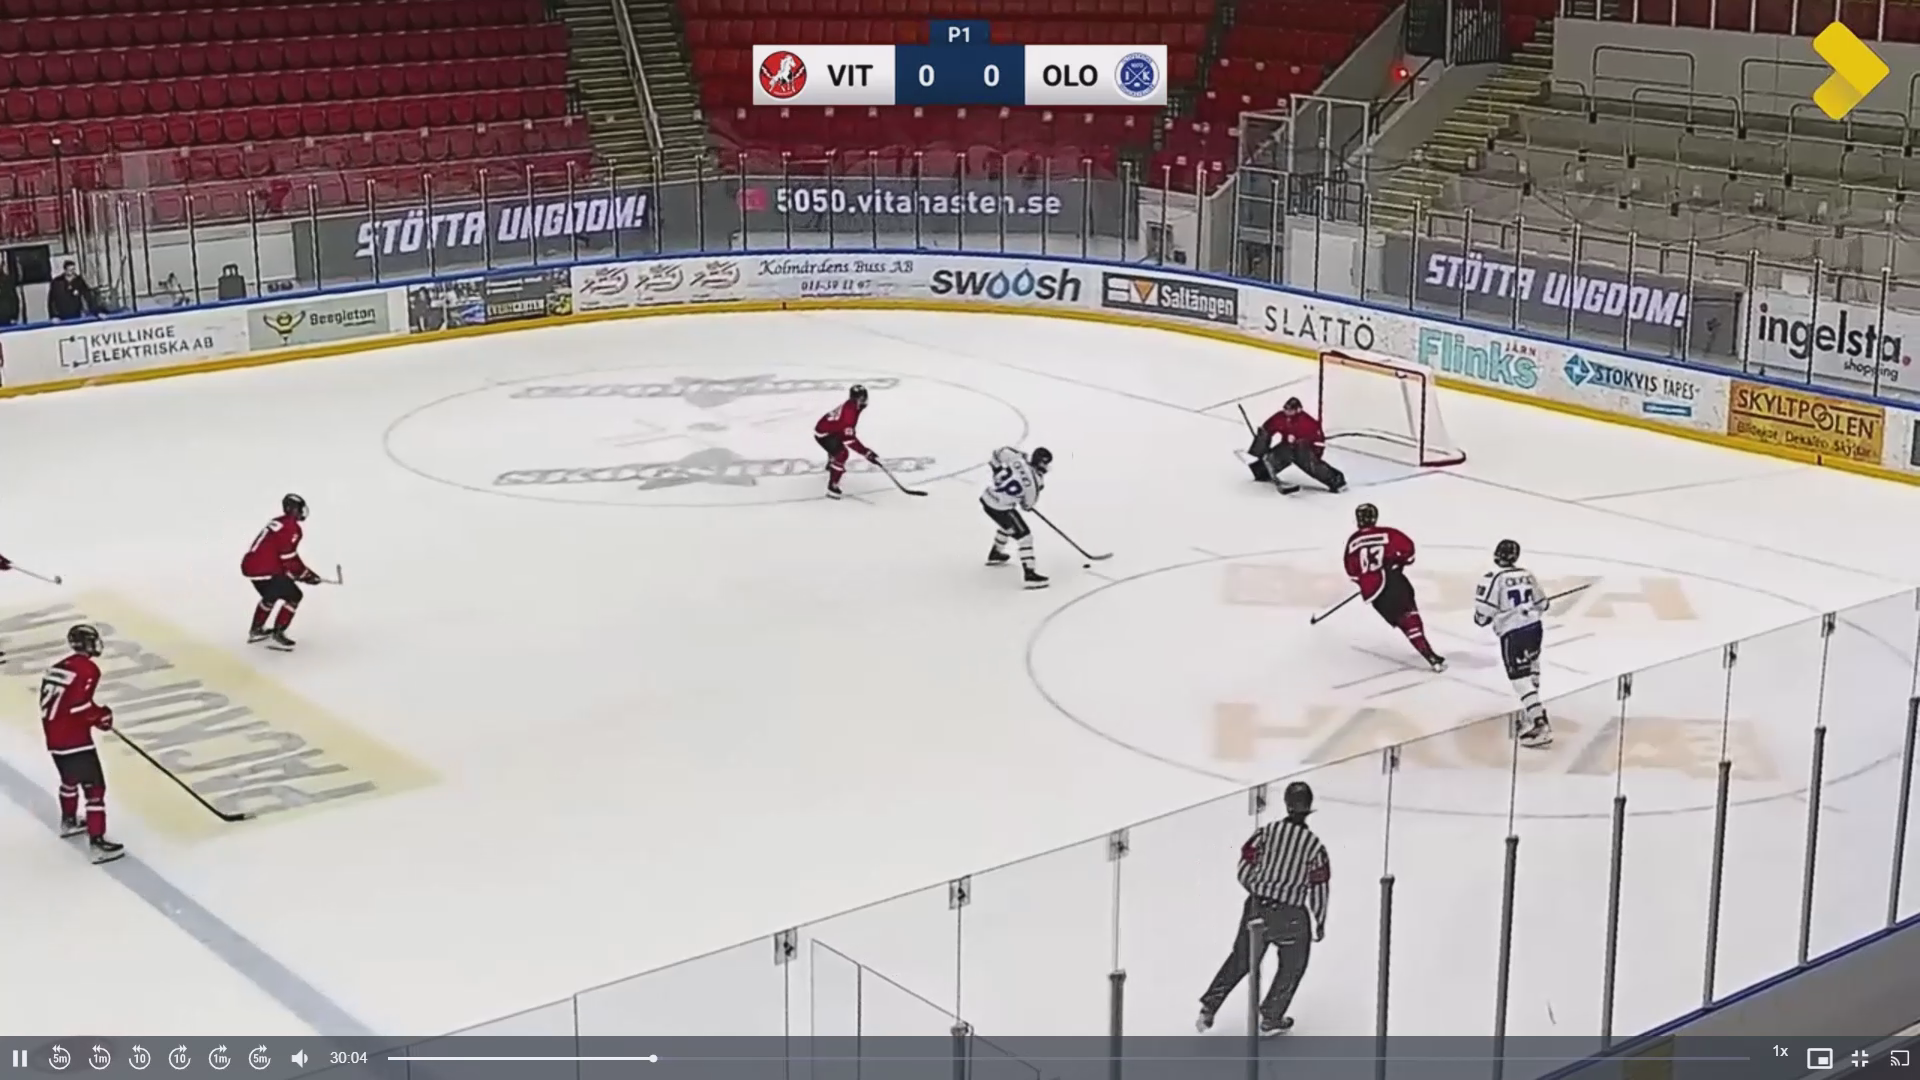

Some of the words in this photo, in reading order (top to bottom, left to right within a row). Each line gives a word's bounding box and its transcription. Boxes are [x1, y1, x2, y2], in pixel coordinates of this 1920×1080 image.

[355, 209, 486, 258] STÖTTA
[498, 195, 647, 242] UNGDOM!
[929, 267, 1082, 302] swoosh
[1160, 284, 1235, 320] Saltängen
[1425, 251, 1537, 301] STÖTTA
[1542, 271, 1688, 328] UNGDOM!
[91, 325, 176, 348] KVILLINGE
[1265, 304, 1375, 351] SLÄTTÖ
[92, 339, 190, 364] ELEKTRISKA
[192, 336, 215, 351] AB
[1418, 326, 1539, 390] Flinks
[1596, 367, 1658, 393] STOKVIS
